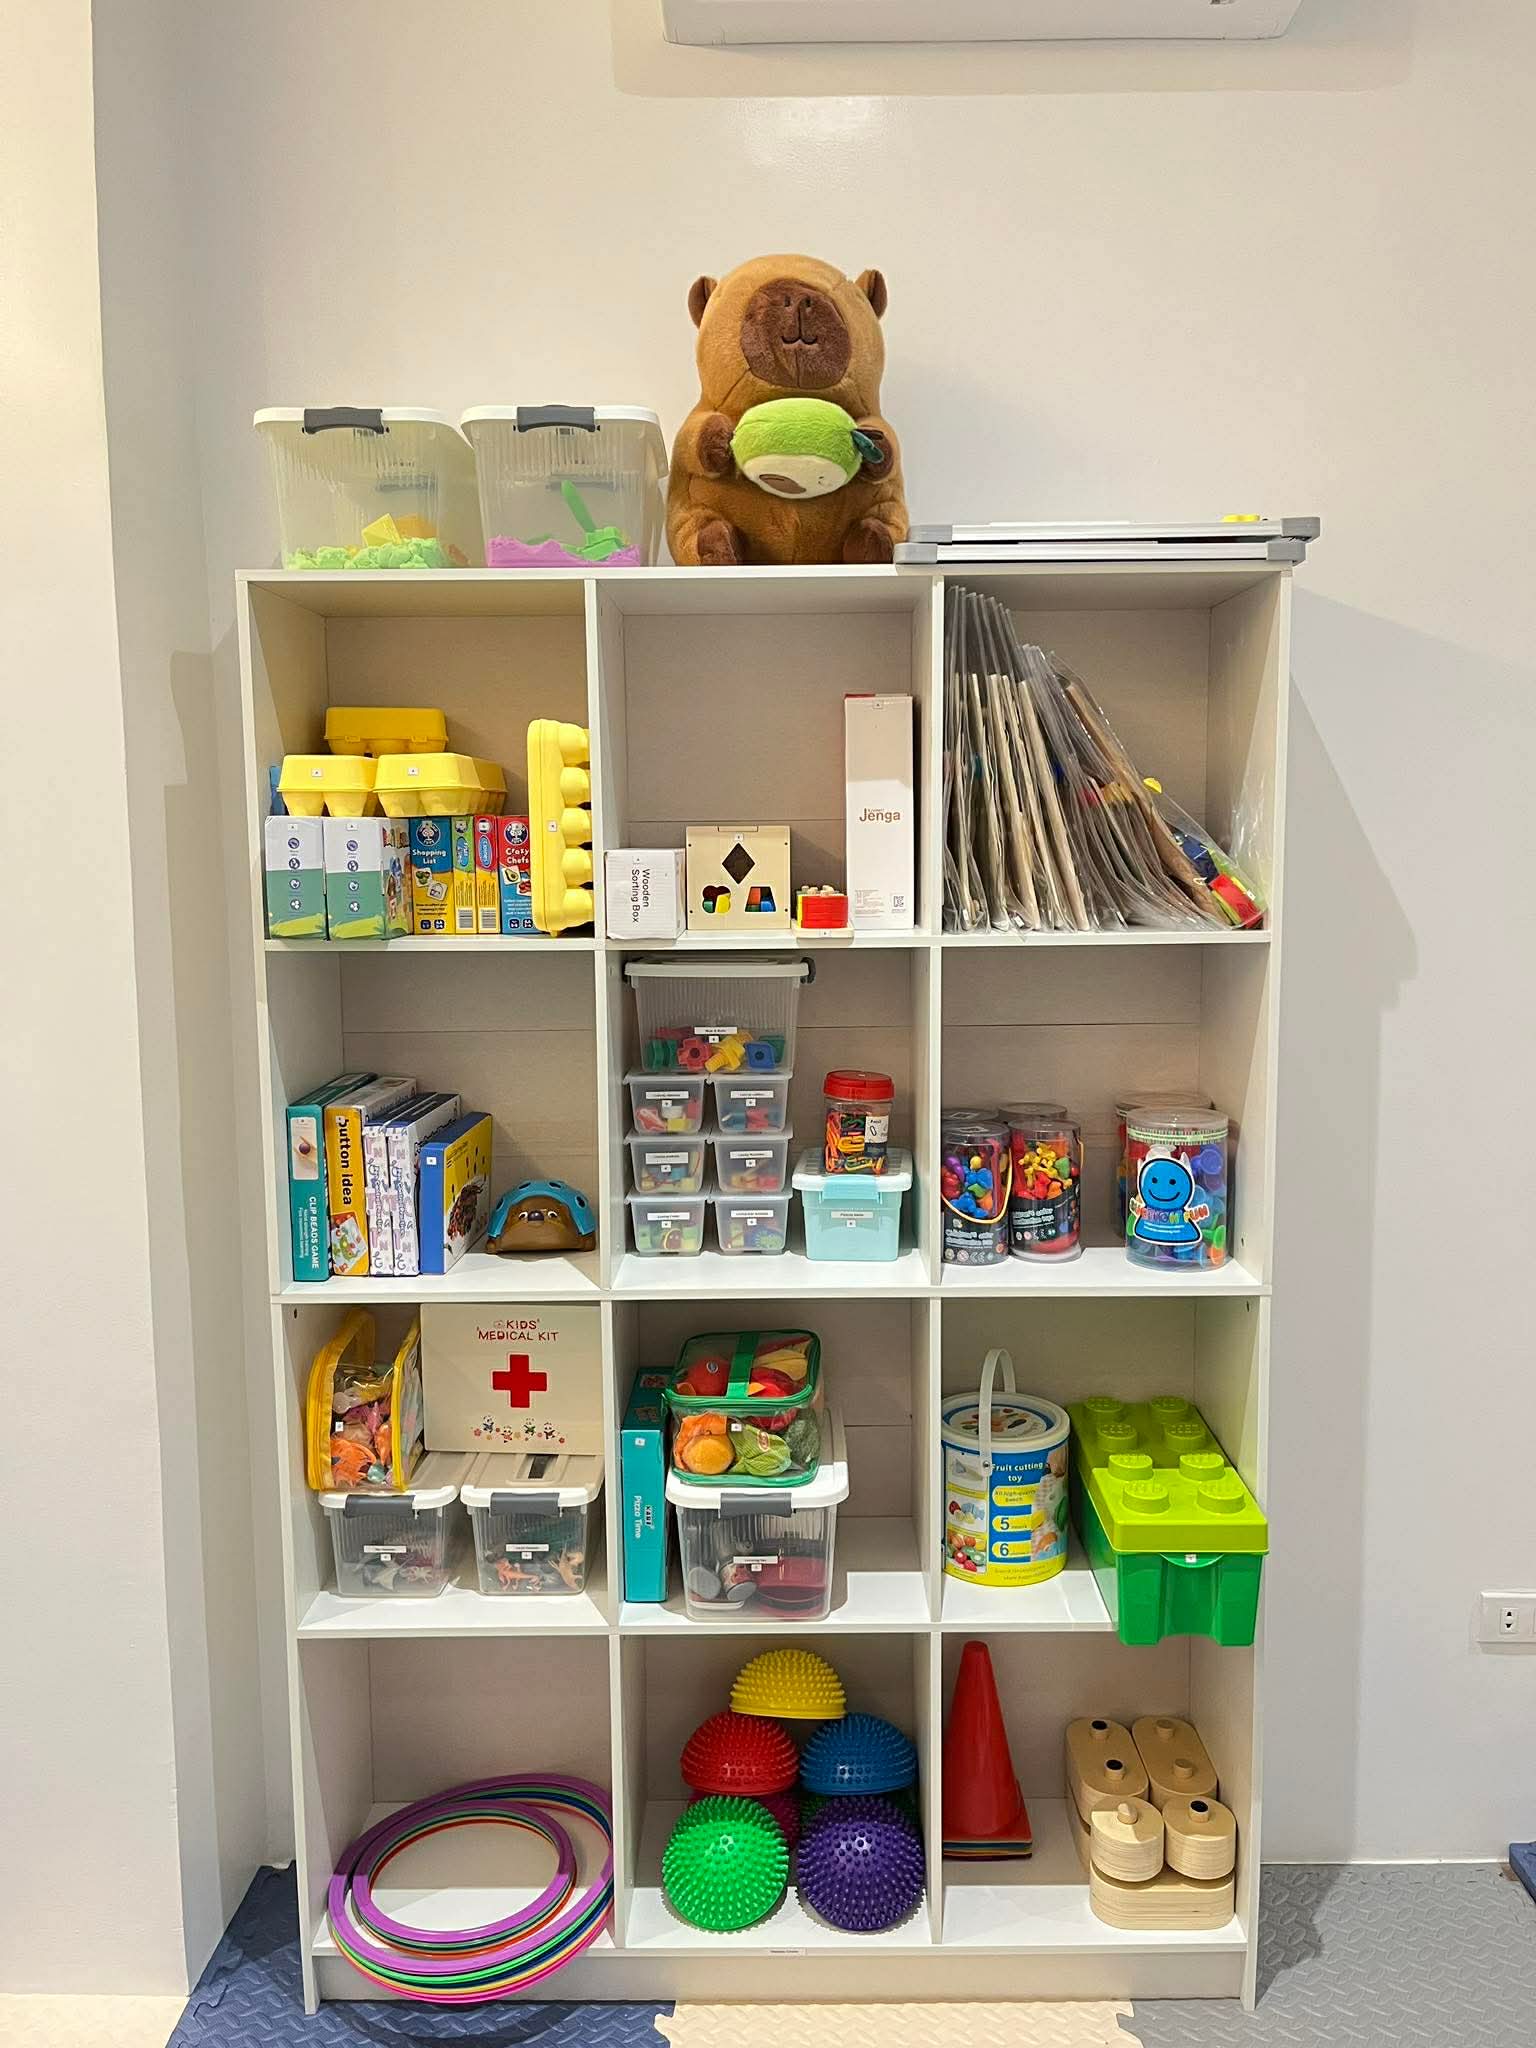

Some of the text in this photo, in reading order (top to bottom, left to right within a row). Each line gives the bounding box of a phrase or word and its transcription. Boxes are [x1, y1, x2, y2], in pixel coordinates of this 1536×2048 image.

[859, 807, 901, 823] Jenga
[412, 848, 447, 857] Shopping
[505, 847, 529, 856] Crazy
[506, 856, 529, 864] Chefs
[642, 868, 651, 908] Wooden
[630, 869, 641, 923] Sorting Box
[339, 1119, 351, 1168] button
[309, 1196, 320, 1269] CLIP BEADS GAME
[538, 1331, 559, 1341] KIT
[1014, 1462, 1043, 1471] cutting
[1008, 1475, 1022, 1483] toy
[1000, 1517, 1010, 1531] 5
[999, 1542, 1009, 1557] 6
